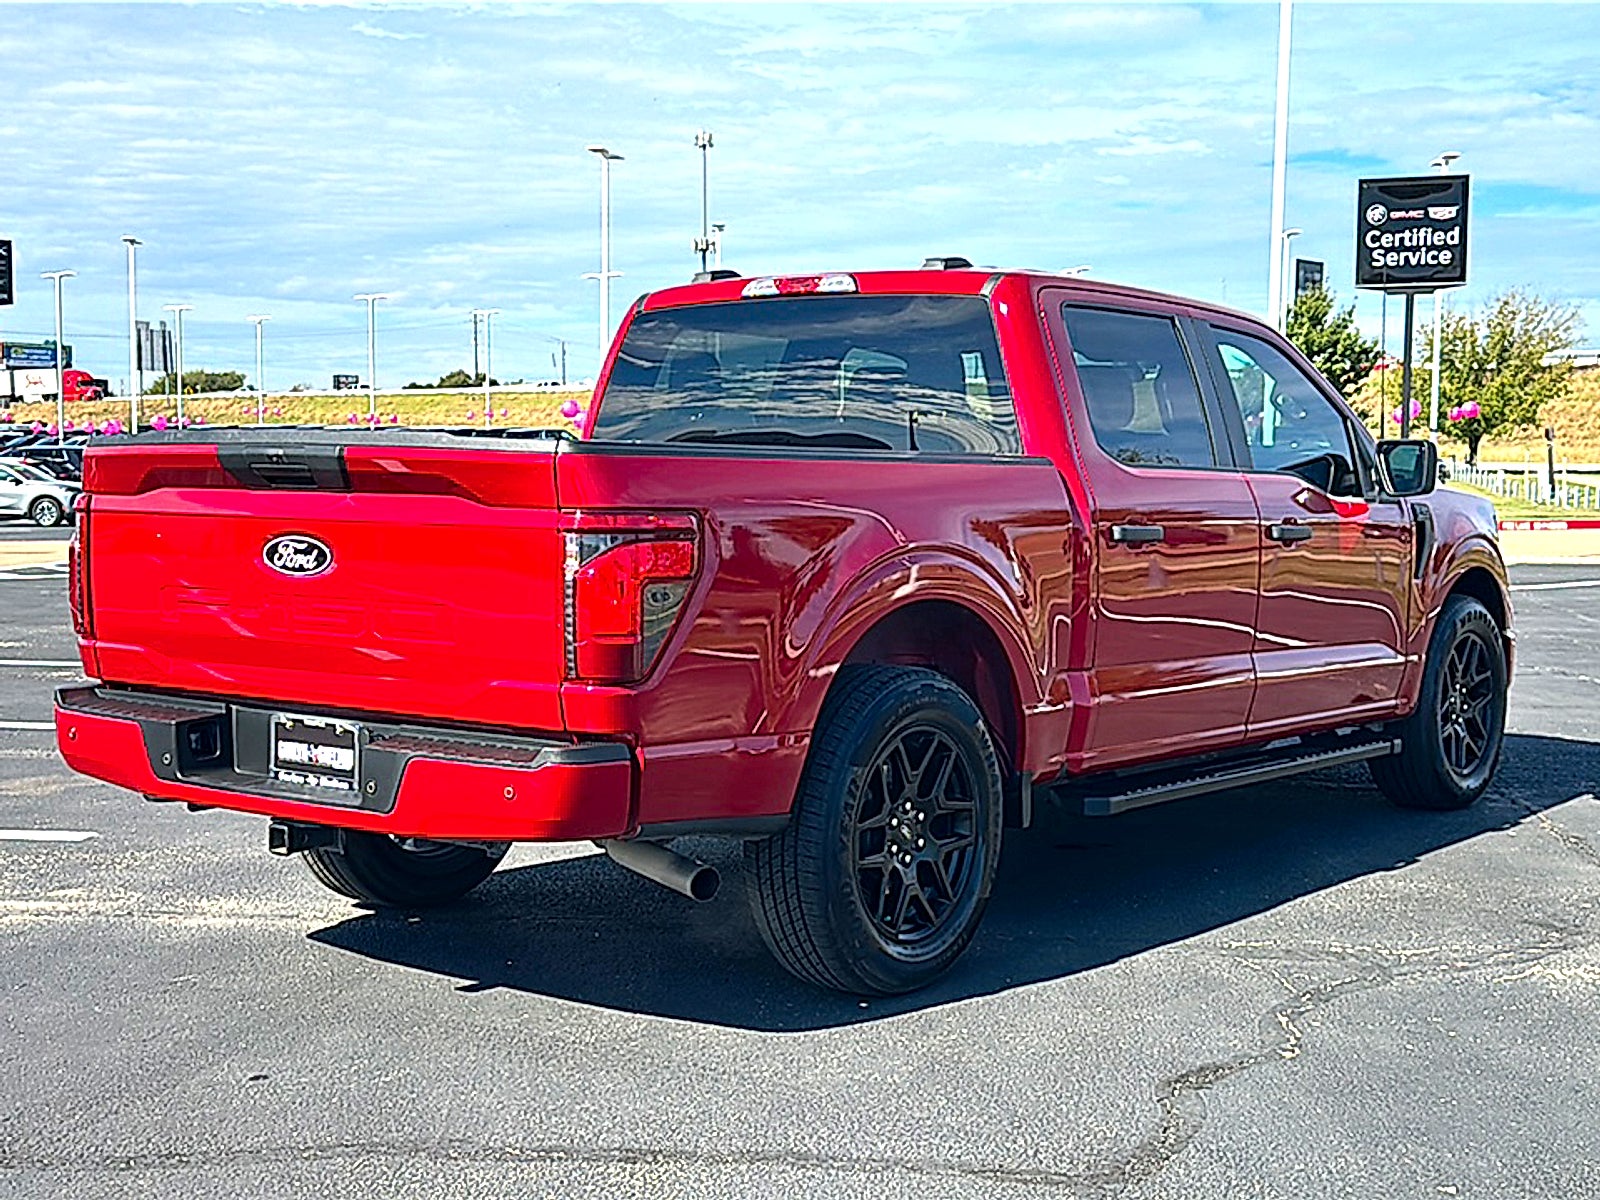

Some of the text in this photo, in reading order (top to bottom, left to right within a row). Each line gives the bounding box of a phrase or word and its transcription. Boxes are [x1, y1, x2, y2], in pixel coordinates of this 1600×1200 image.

[1389, 210, 1425, 219] GMC
[1365, 226, 1460, 248] Certified
[1371, 247, 1453, 267] Service
[273, 540, 318, 569] Ford
